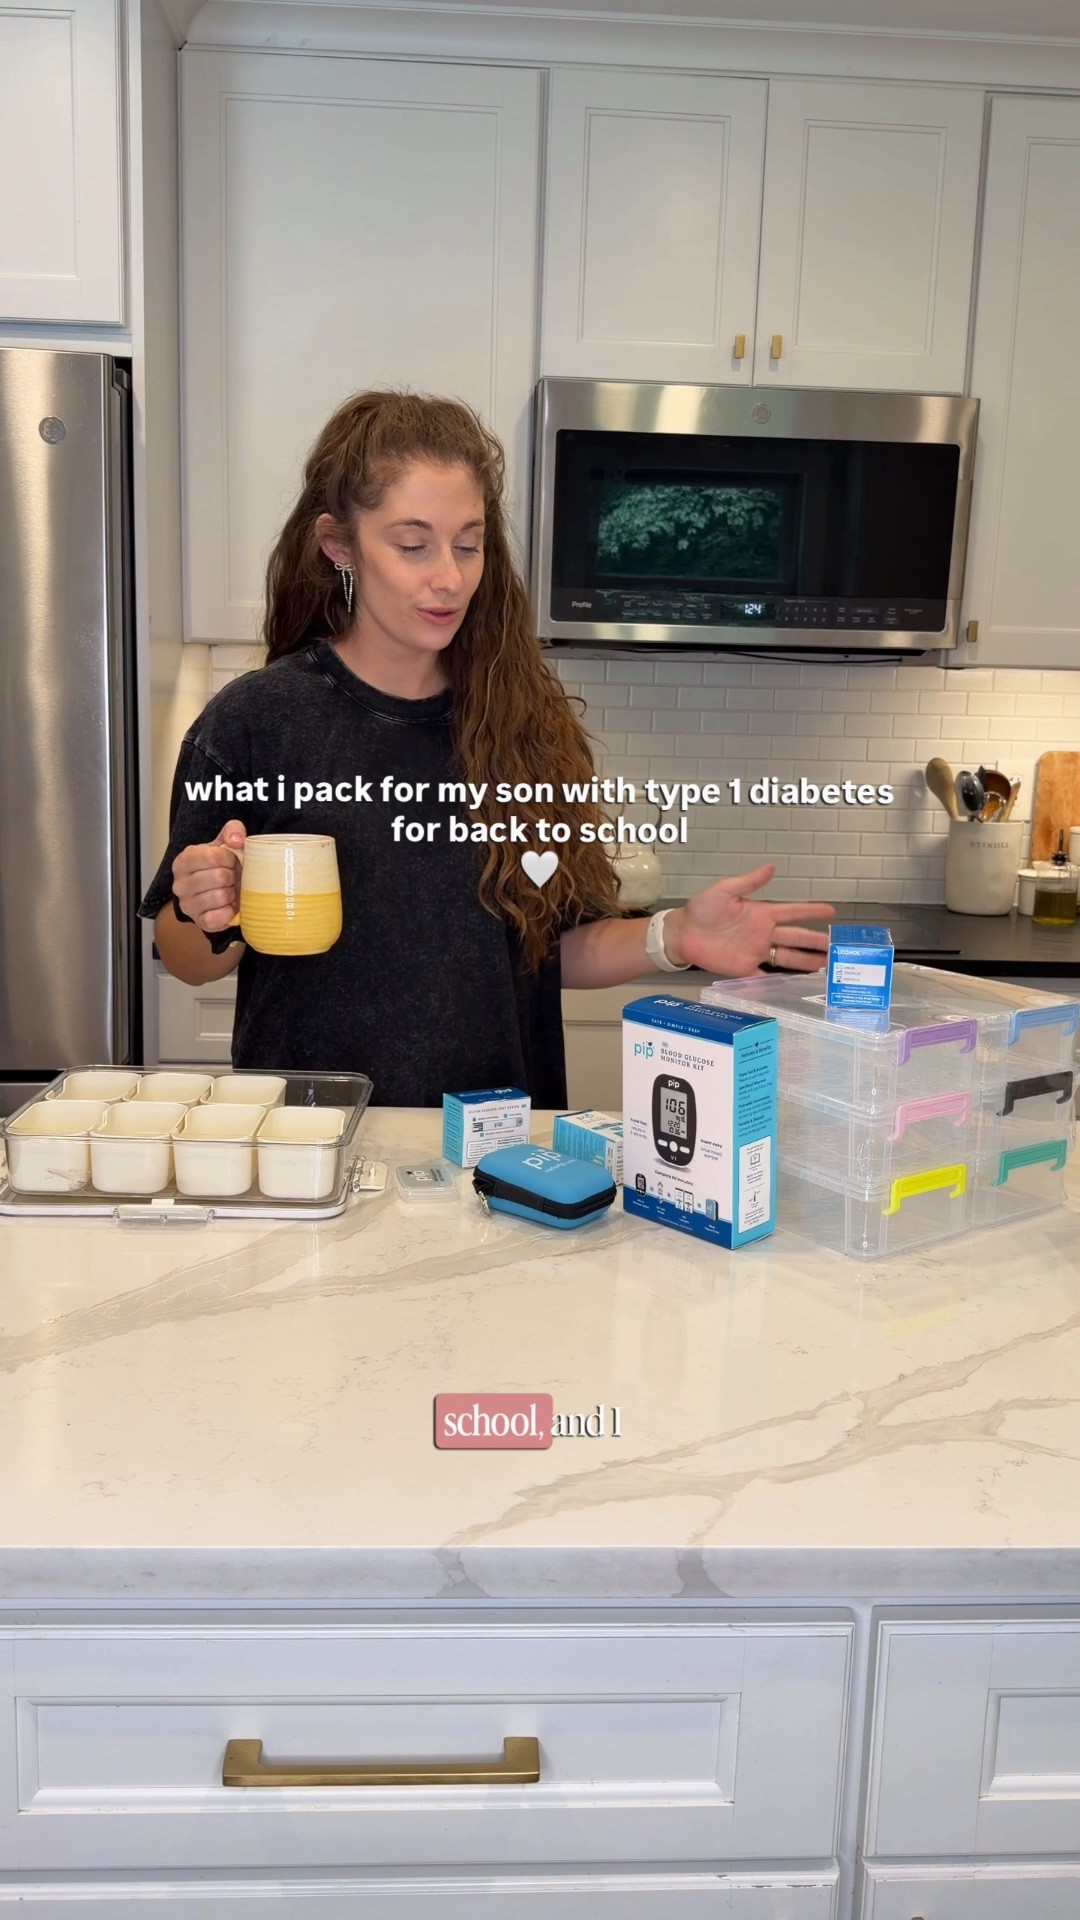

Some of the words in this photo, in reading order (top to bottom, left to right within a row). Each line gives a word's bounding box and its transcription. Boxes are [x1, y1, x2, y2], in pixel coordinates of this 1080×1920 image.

[572, 601, 592, 609] Profile
[970, 841, 1009, 849] UTENSILS
[833, 949, 860, 957] ALCOHOL
[634, 1042, 654, 1059] pip
[660, 1048, 682, 1059] BLOOD
[684, 1054, 715, 1067] GLUCOSE
[660, 1055, 691, 1068] MONITOR
[692, 1063, 705, 1072] KIT
[668, 1079, 680, 1089] pip
[665, 1098, 686, 1116] 106
[522, 1149, 562, 1170] pip
